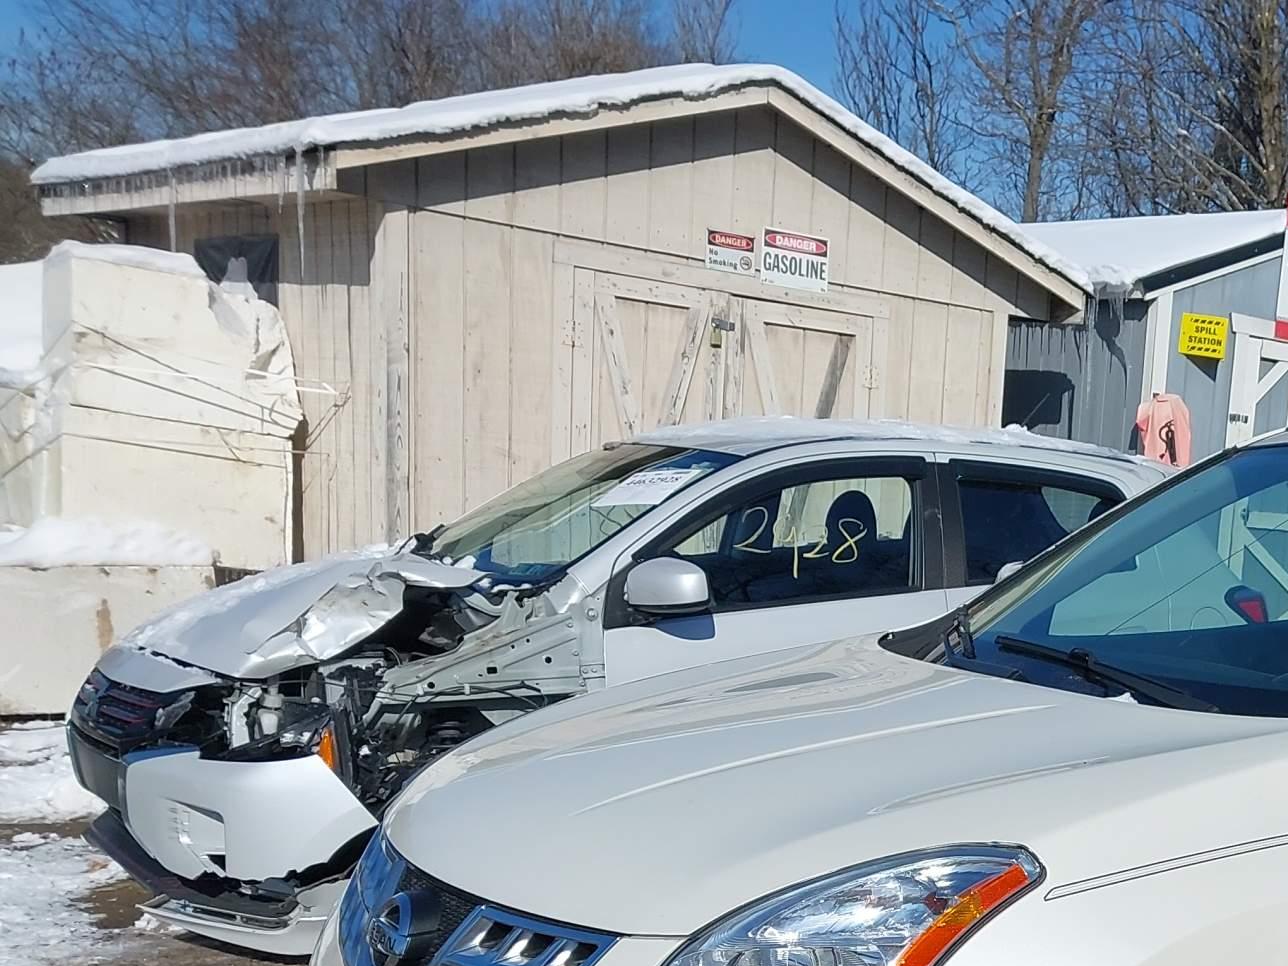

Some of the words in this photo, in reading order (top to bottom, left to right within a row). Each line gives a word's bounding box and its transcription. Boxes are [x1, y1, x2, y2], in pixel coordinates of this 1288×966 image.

[715, 235, 747, 248] DANGER
[775, 235, 817, 251] DANGER
[709, 248, 719, 256] No
[709, 257, 738, 271] Smoking
[763, 252, 827, 281] GASOLINE
[1194, 326, 1217, 336] SPILL
[1188, 336, 1222, 347] STATION
